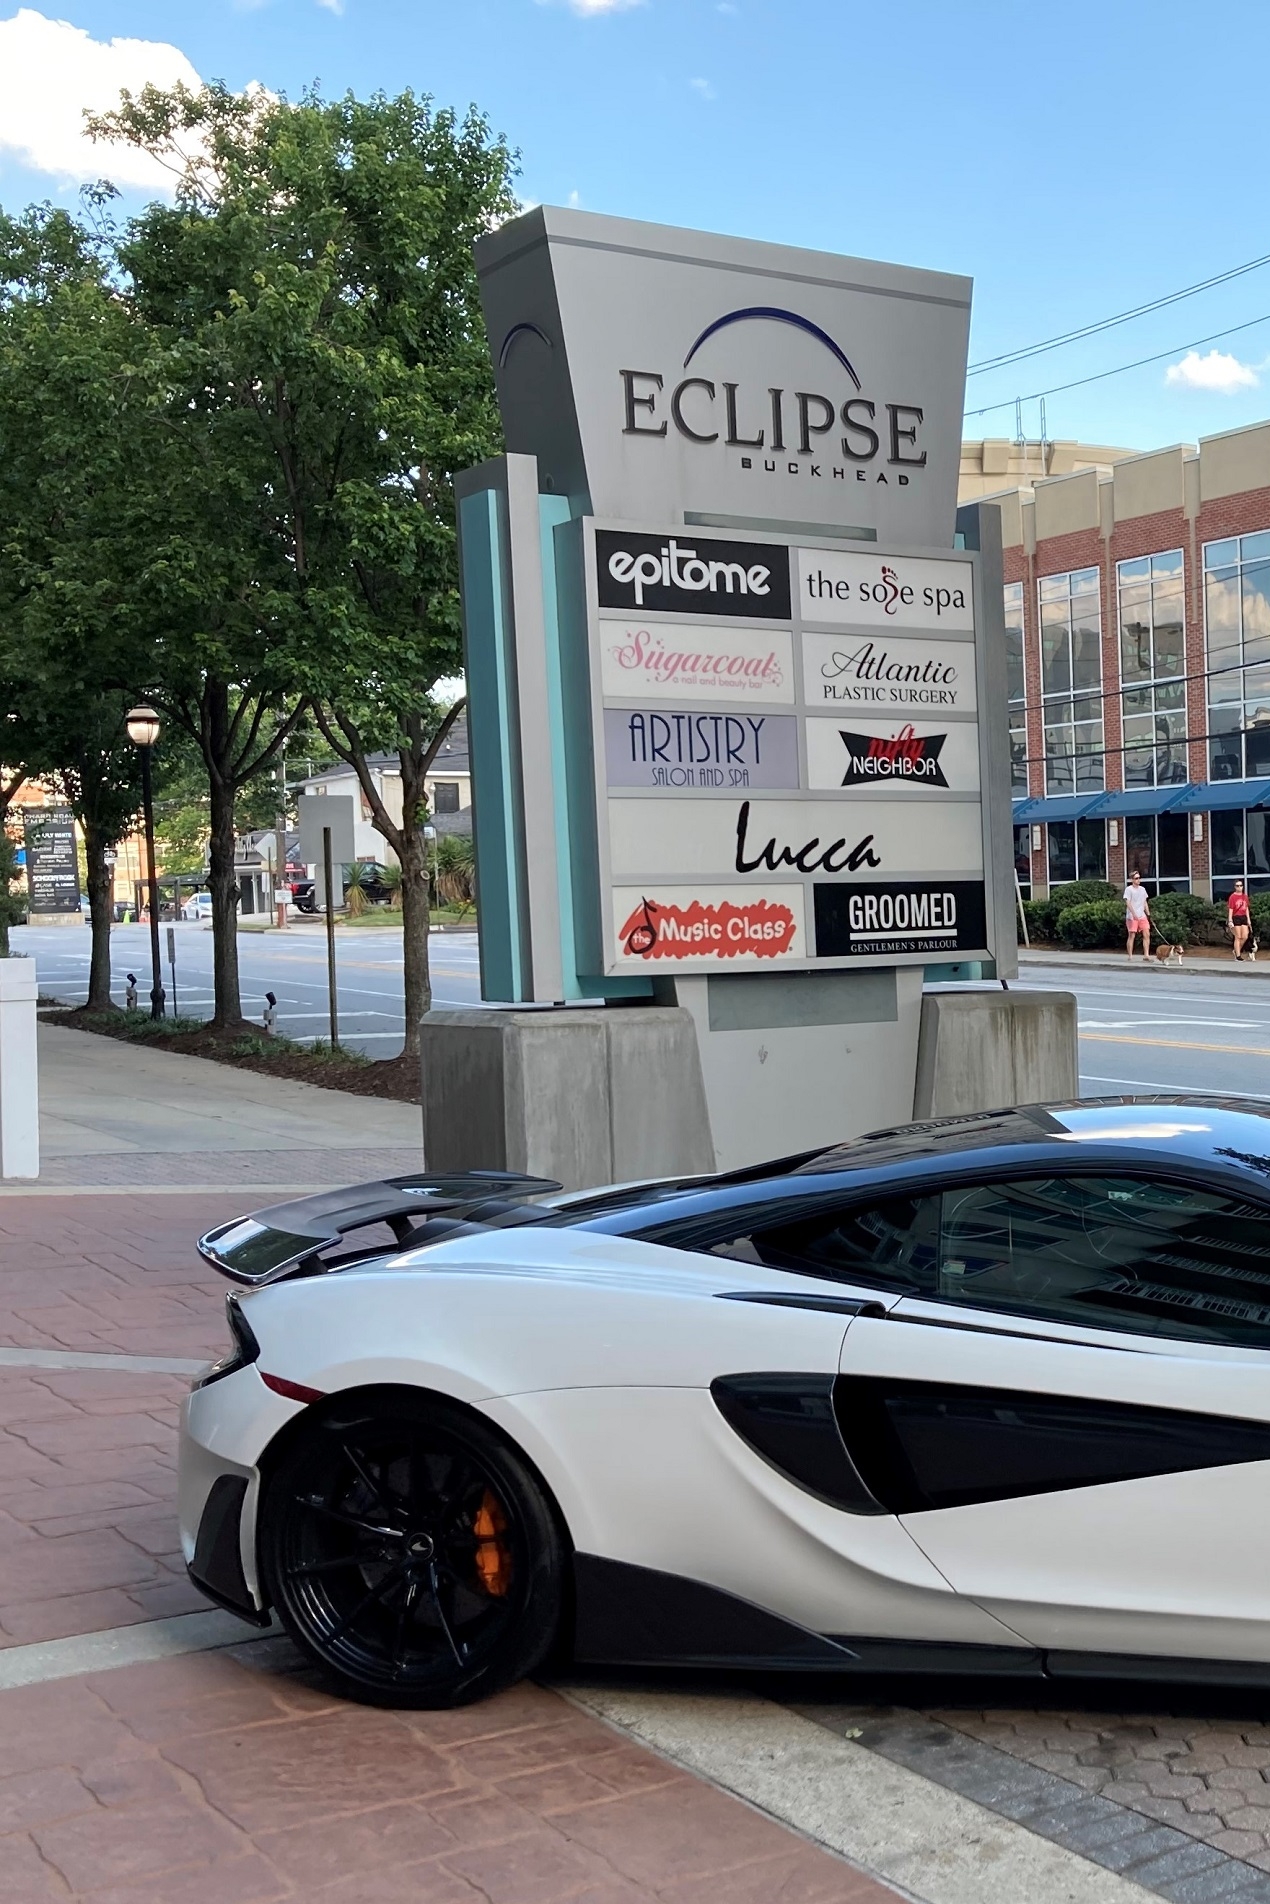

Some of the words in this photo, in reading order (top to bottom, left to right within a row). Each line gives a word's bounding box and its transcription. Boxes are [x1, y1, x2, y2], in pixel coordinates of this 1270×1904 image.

[619, 369, 928, 469] ECLIPSE
[741, 457, 910, 486] BUCKHEAD
[608, 540, 772, 605] epitome
[806, 571, 850, 600] the
[923, 587, 966, 616] spa
[614, 630, 780, 683] Sugarcoat
[821, 642, 959, 684] Atlantic
[673, 676, 680, 684] a
[681, 674, 698, 685] nail
[700, 675, 717, 686] and
[719, 676, 747, 690] beauty
[749, 679, 763, 689] bar
[823, 685, 887, 701] PLASTIC
[890, 688, 958, 704] SURGERY
[628, 713, 766, 764] ARTISTRY
[868, 723, 926, 768] nifty
[652, 767, 695, 787] SALON
[699, 768, 725, 787] AND
[728, 768, 750, 787] SPA
[852, 755, 937, 776] NEIGHBOR
[735, 800, 882, 873] Lucca
[658, 916, 723, 943] Music
[727, 915, 786, 942] Class
[849, 892, 957, 931] GROOMED
[633, 932, 651, 945] the
[850, 941, 916, 953] GENTLEMEN'S
[918, 940, 958, 950] PARLOUR
